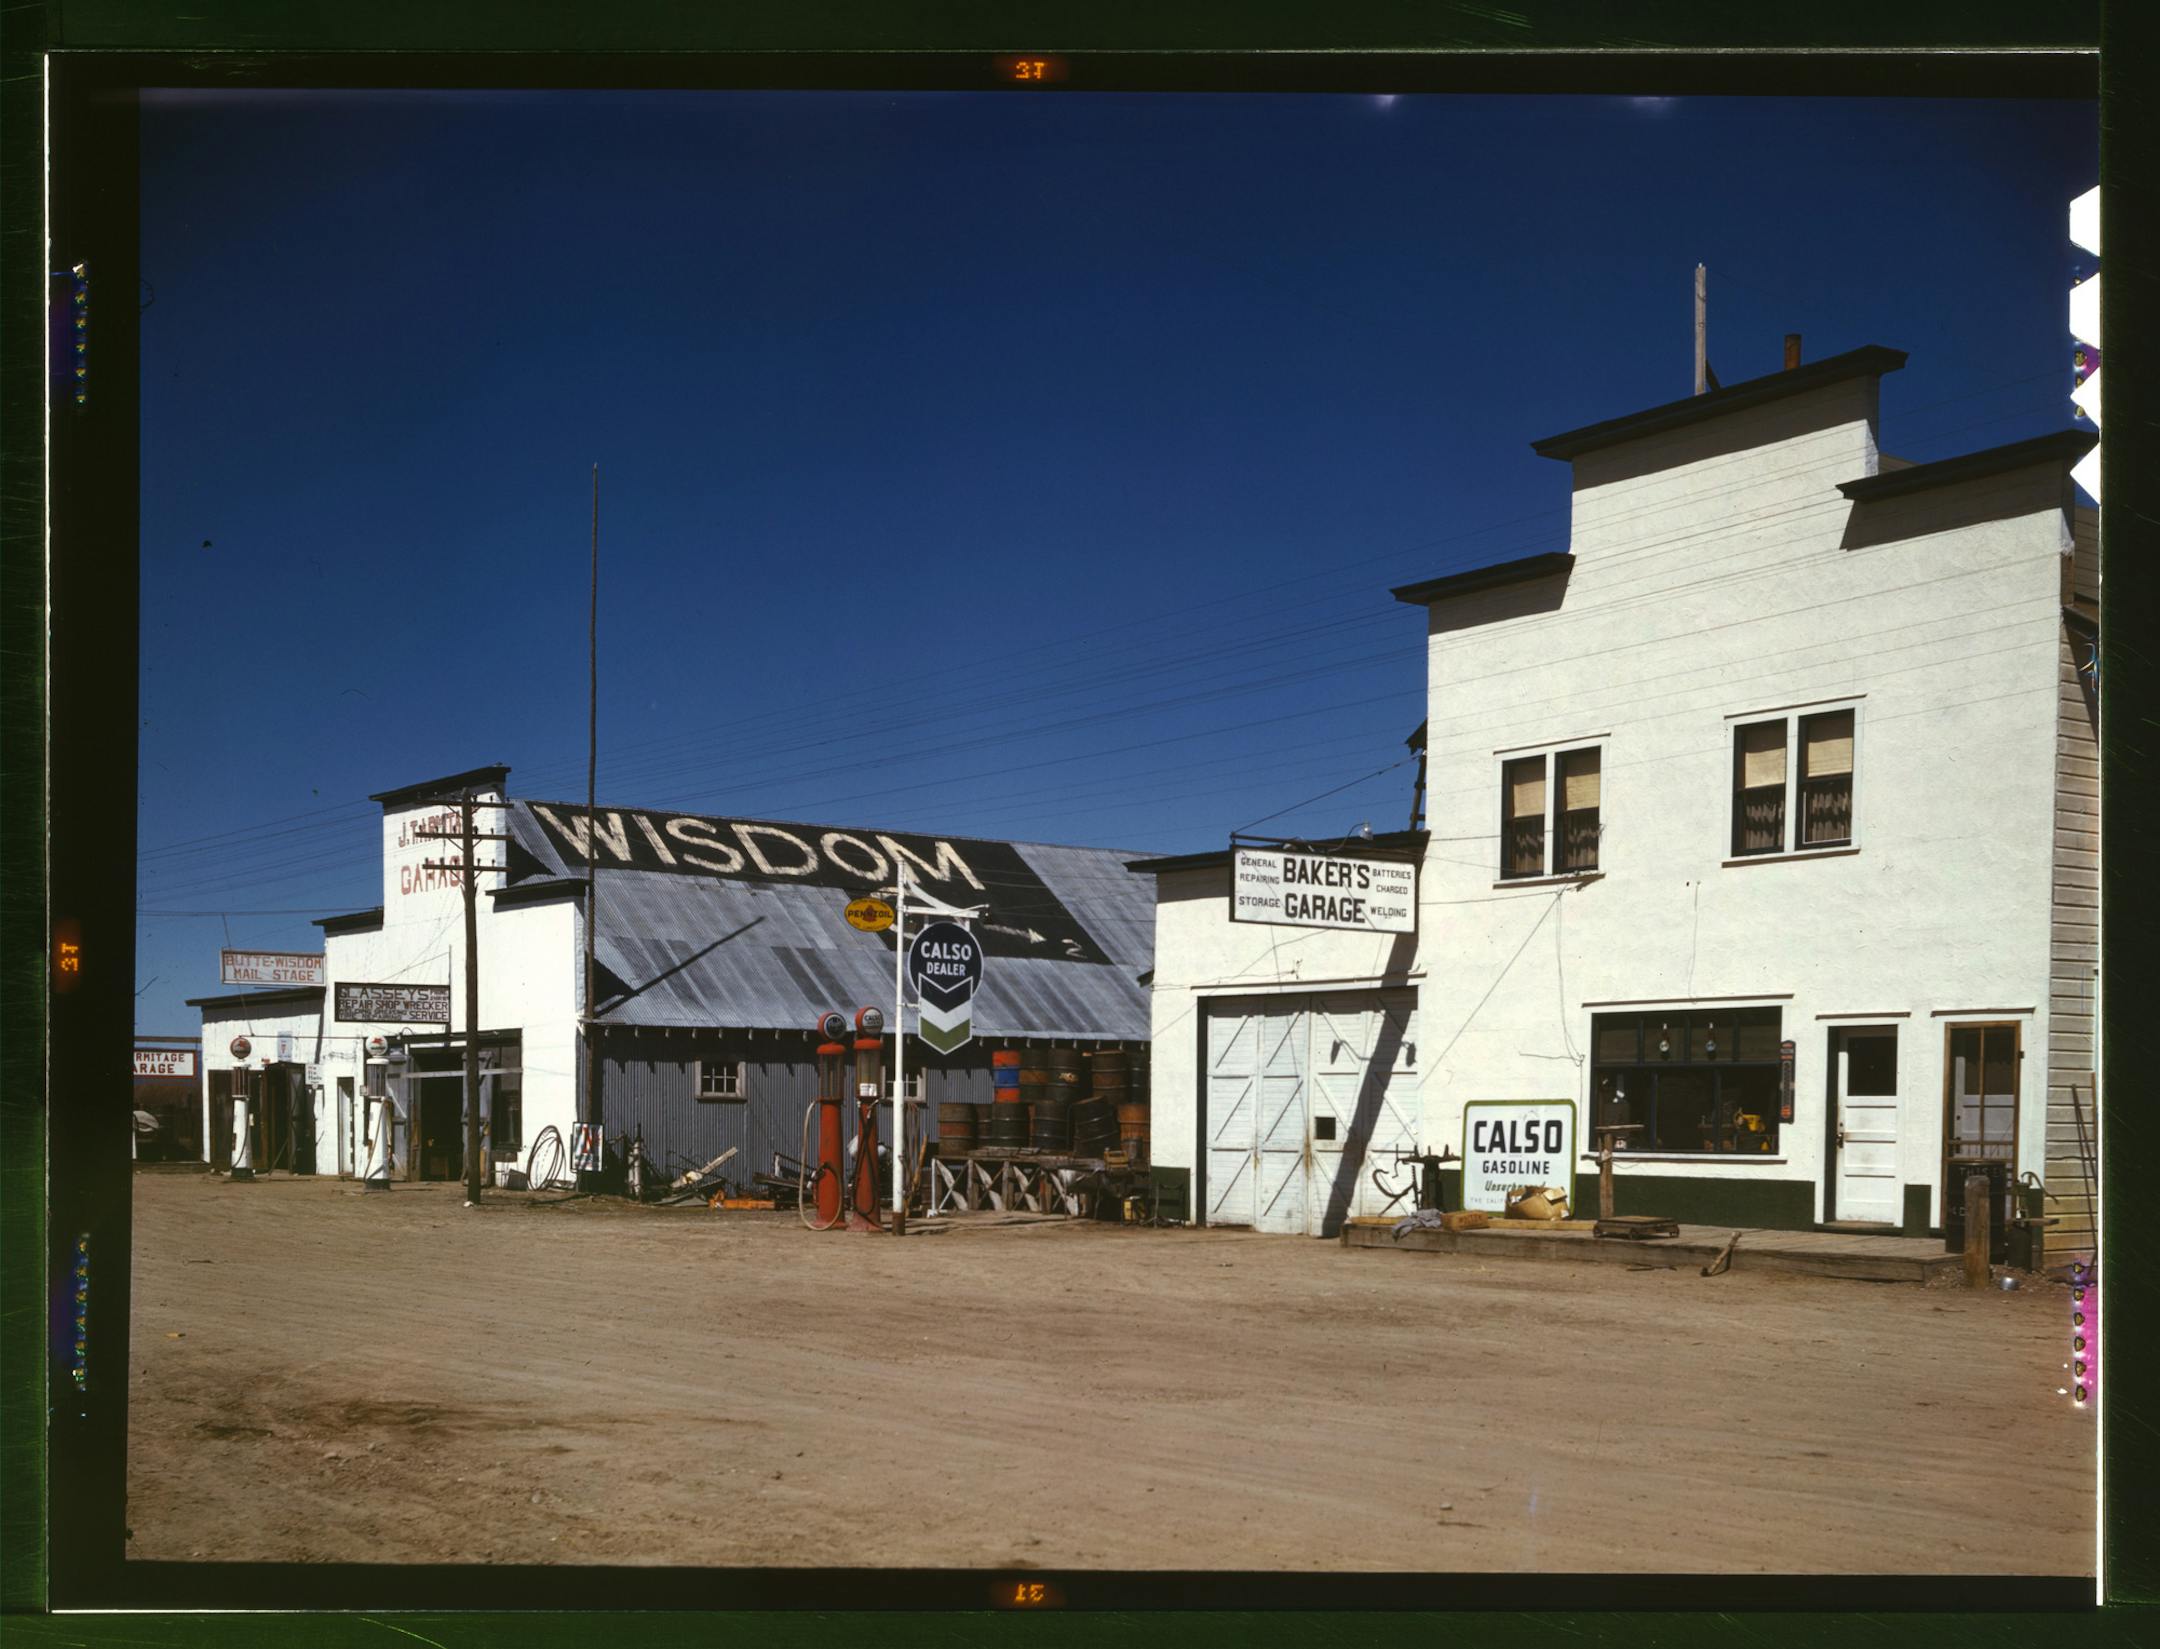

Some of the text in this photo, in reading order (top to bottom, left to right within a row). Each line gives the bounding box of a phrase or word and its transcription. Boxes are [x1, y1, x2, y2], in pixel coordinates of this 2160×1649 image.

[533, 804, 986, 890] WISDOM
[401, 855, 465, 895] GARAG
[1240, 856, 1412, 889] GENERAL BAKER'S BATTERIES
[1239, 873, 1408, 895] REPAIRING CHARGED
[1238, 893, 1407, 923] STORAGE GARAGE WELDING
[920, 941, 972, 961] CALSO
[233, 968, 315, 981] MAIL STAGE
[926, 961, 966, 976] DEALER
[339, 1000, 448, 1010] REPAIR SHOP WRECKER
[409, 1011, 447, 1020] SERVICE
[1473, 1120, 1563, 1154] CALSO
[1482, 1160, 1551, 1174] GASOLINE
